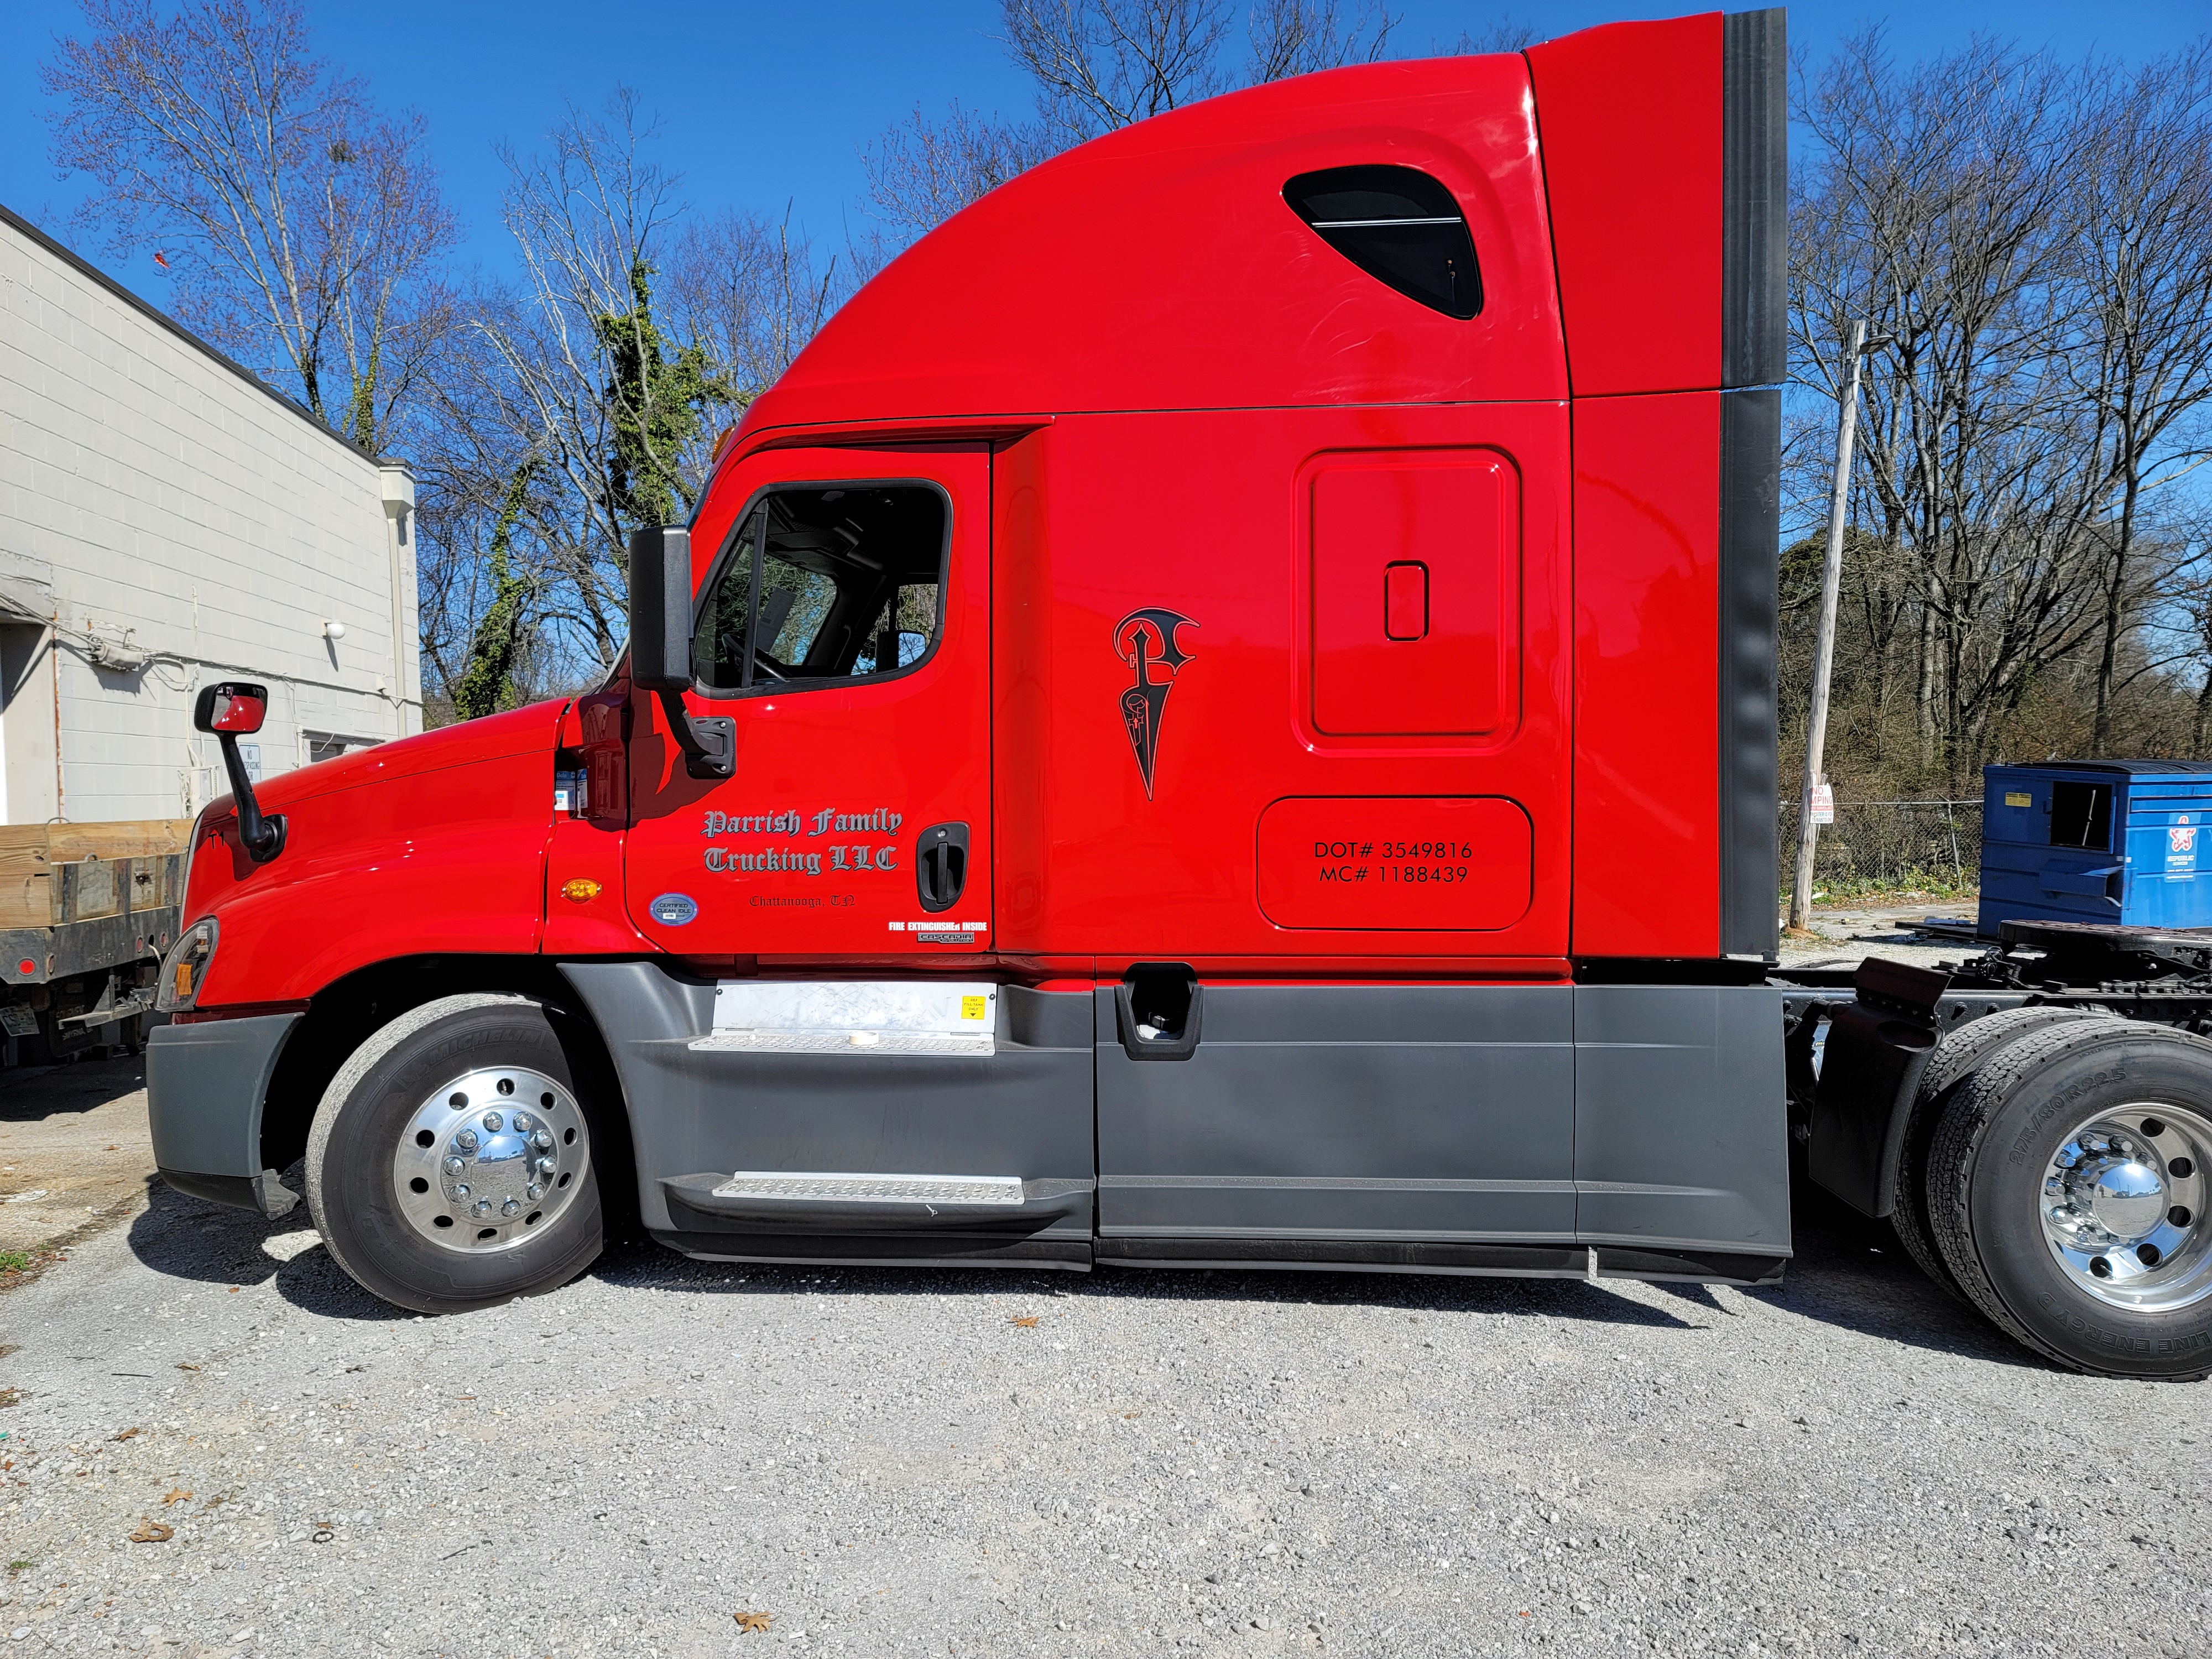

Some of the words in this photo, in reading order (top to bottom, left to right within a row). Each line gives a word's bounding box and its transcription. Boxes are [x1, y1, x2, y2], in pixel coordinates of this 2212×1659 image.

[247, 750, 252, 759] NO
[1812, 786, 1823, 795] NO
[701, 810, 801, 838] Parrish
[807, 807, 902, 837] Family
[1315, 842, 1374, 858] DOT#
[1383, 842, 1472, 858] 3549816
[703, 847, 822, 876] Trucking
[828, 845, 898, 872] LLC
[1319, 866, 1369, 882] MC#
[1379, 866, 1468, 883] 1188439
[749, 895, 825, 908] Chattanooga,
[830, 895, 855, 907] TN
[889, 922, 905, 930] FIRE
[907, 922, 960, 930] EXTINGUISHER
[962, 922, 987, 930] INSIDE
